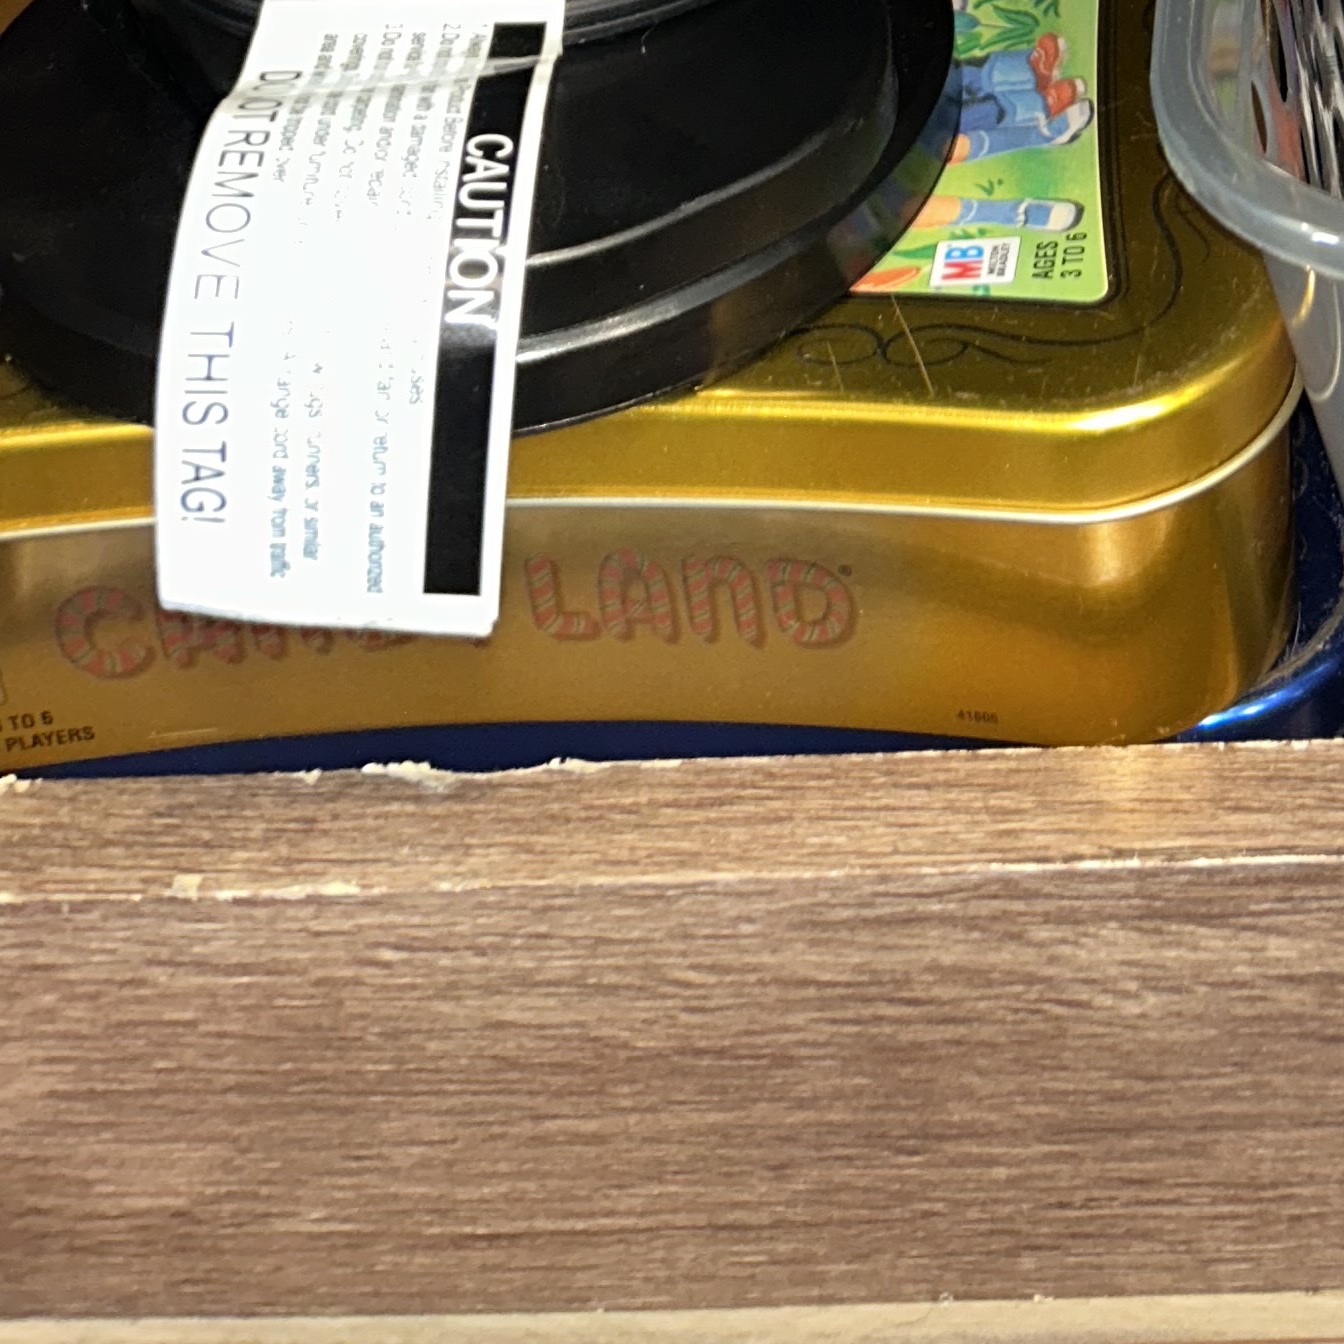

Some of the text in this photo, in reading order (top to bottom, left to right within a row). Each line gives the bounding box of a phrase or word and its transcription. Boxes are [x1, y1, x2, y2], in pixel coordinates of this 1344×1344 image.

[193, 129, 272, 300] REMOVE
[446, 133, 513, 331] CAUTION
[941, 243, 985, 281] MB
[1031, 240, 1059, 280] AGES
[1060, 231, 1088, 279] 3 TO 6
[181, 322, 235, 427] THIS
[180, 441, 227, 524] TAG!
[267, 465, 288, 503] away
[5, 725, 96, 753] PLAYERS
[9, 710, 53, 730] TO 5
